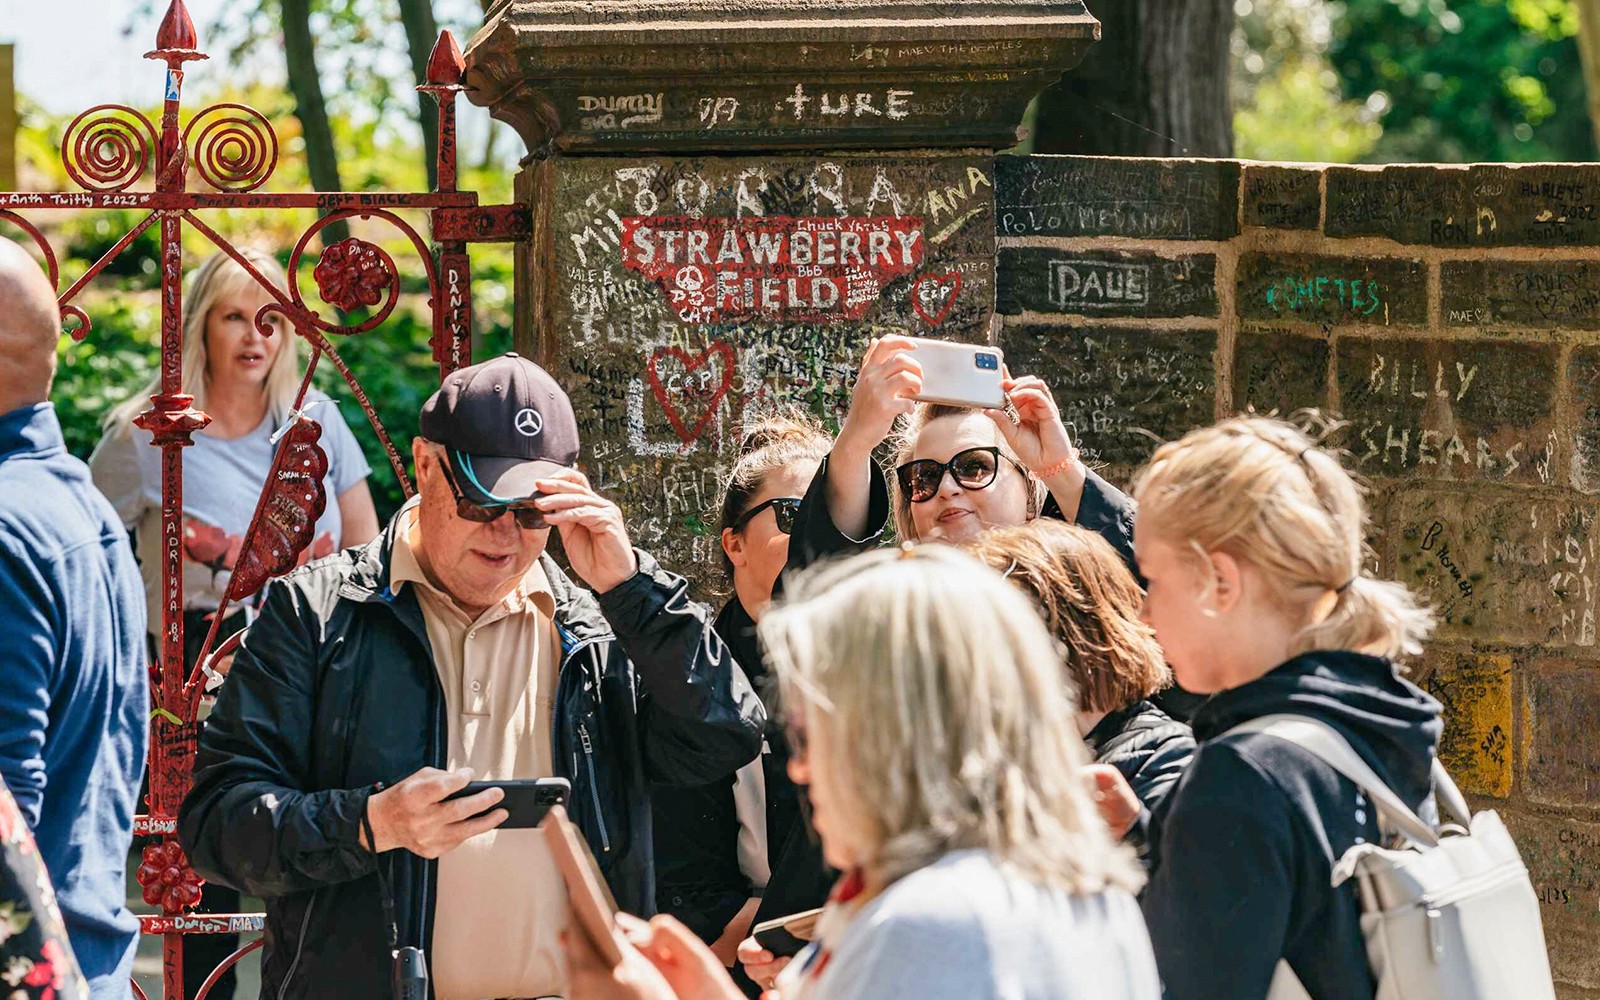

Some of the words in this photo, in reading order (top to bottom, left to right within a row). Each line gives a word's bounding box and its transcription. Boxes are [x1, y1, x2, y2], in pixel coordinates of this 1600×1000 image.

[102, 195, 138, 206] 2022
[632, 225, 921, 266] STRAWBERRY
[796, 219, 843, 232] Chuck
[716, 270, 840, 308] FIELD
[448, 268, 462, 372] DANIVER
[1370, 352, 1480, 402] BILLY
[1359, 420, 1523, 478] SHEARS
